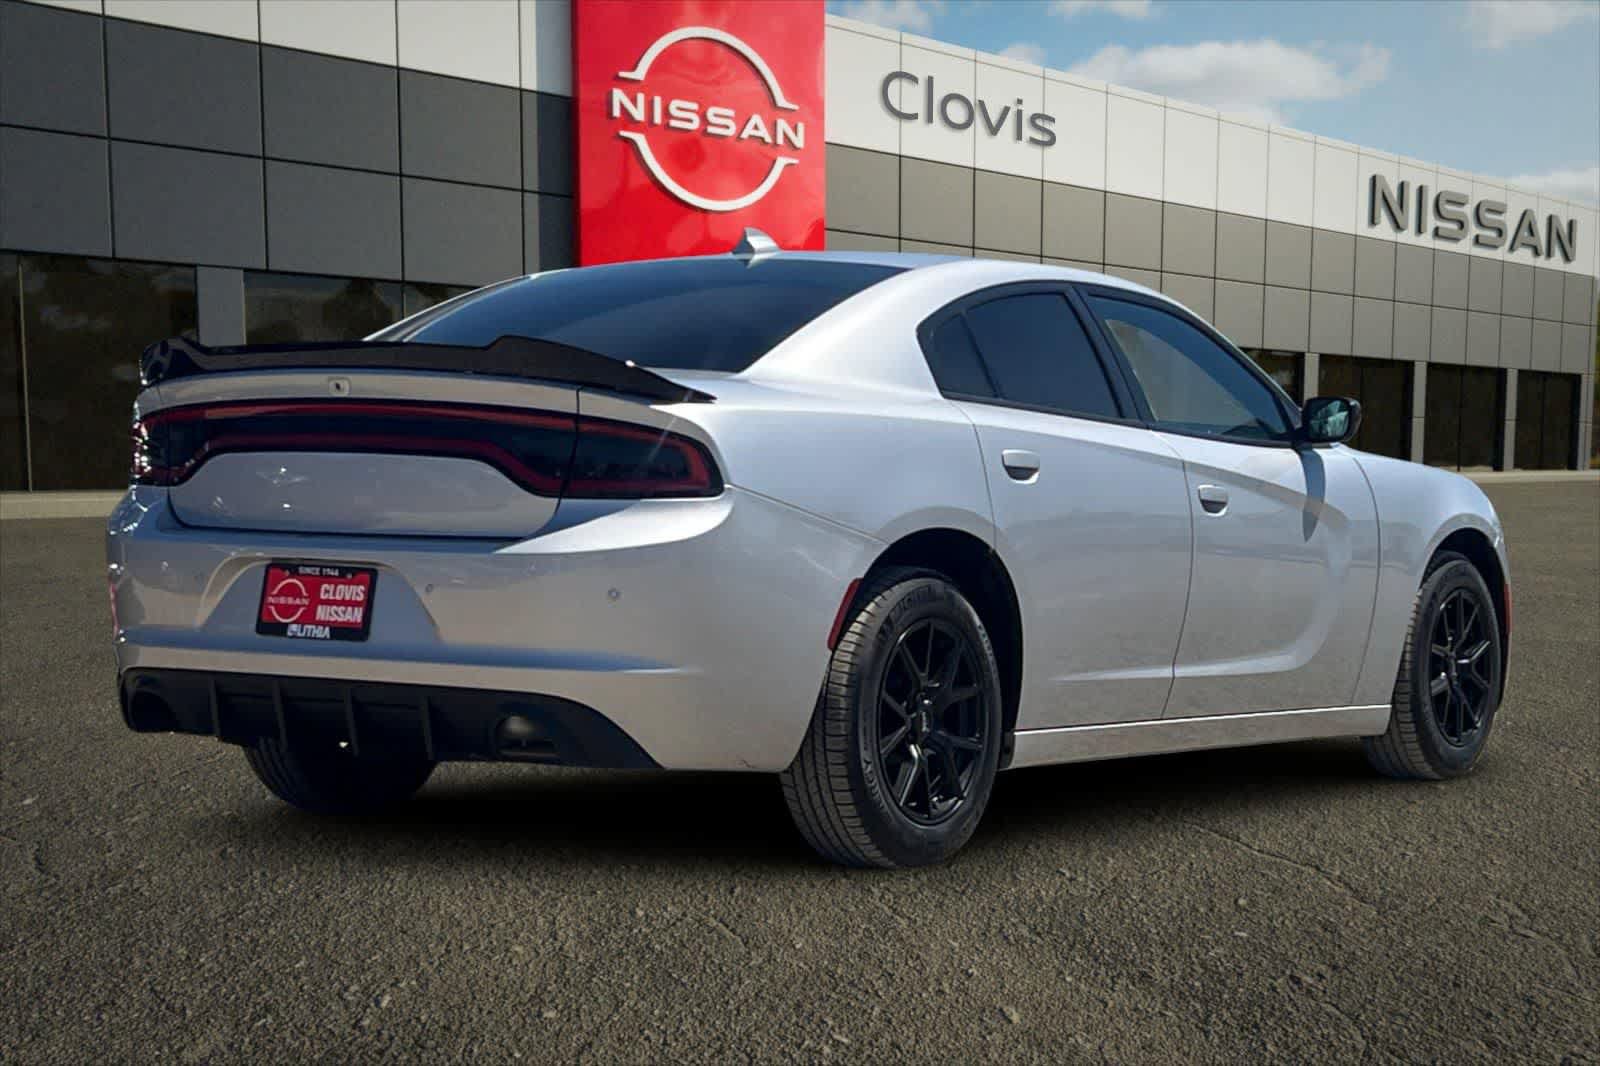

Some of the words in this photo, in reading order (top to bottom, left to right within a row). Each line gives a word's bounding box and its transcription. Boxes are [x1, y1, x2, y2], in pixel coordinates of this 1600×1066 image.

[611, 86, 806, 150] NISSAN
[880, 70, 1057, 148] Clovis
[1368, 173, 1578, 263] NISSAN
[298, 566, 320, 576] SINCE
[266, 595, 311, 606] NISSAN
[319, 583, 366, 602] CLOVIS
[315, 604, 363, 624] NISSAN
[298, 624, 331, 639] LITHIA
